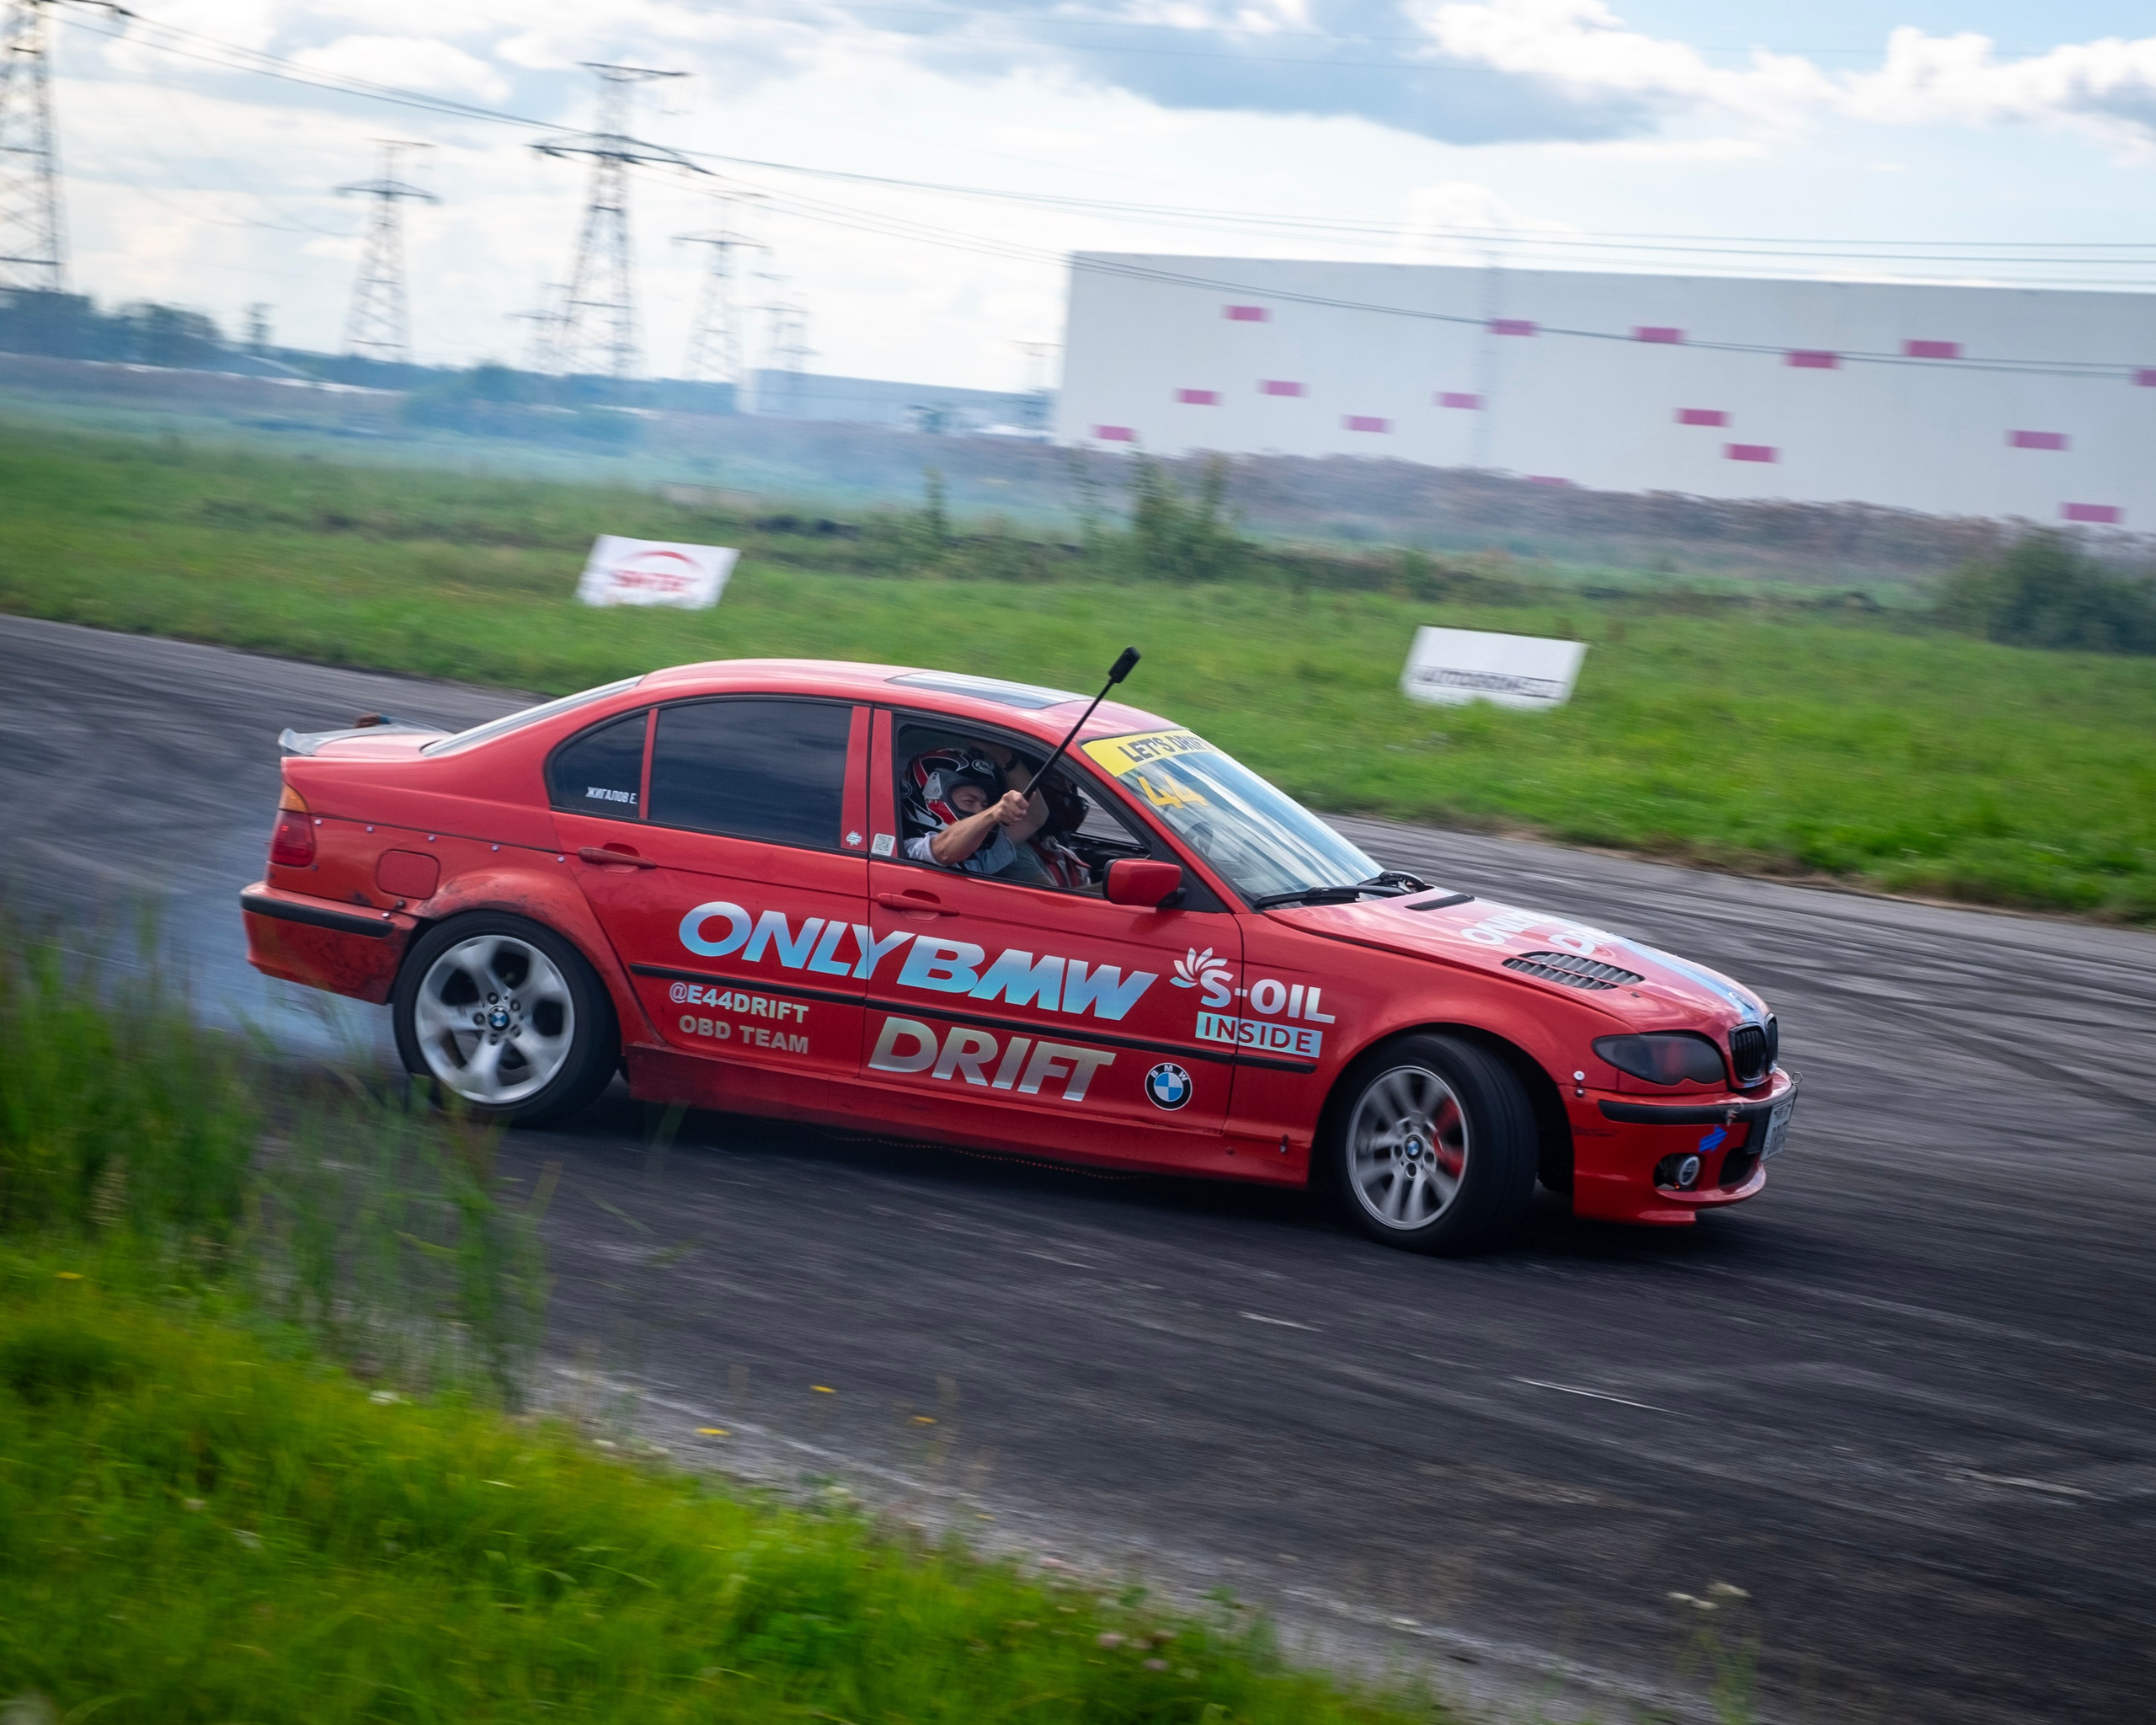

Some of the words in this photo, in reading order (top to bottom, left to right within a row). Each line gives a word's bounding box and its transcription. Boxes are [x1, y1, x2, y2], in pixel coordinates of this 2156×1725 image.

[1117, 737, 1176, 762] LET'S
[1138, 776, 1209, 809] 44
[678, 900, 1159, 1021] ONLYBMW
[669, 981, 809, 1024] @E44DRIFT
[1199, 969, 1336, 1024] S-OIL
[679, 1014, 731, 1039] OBD
[739, 1024, 808, 1055] TEAM
[1204, 1016, 1313, 1054] INSIDE
[867, 1016, 1116, 1102] DRIFT
[1150, 1064, 1188, 1082] BMW
